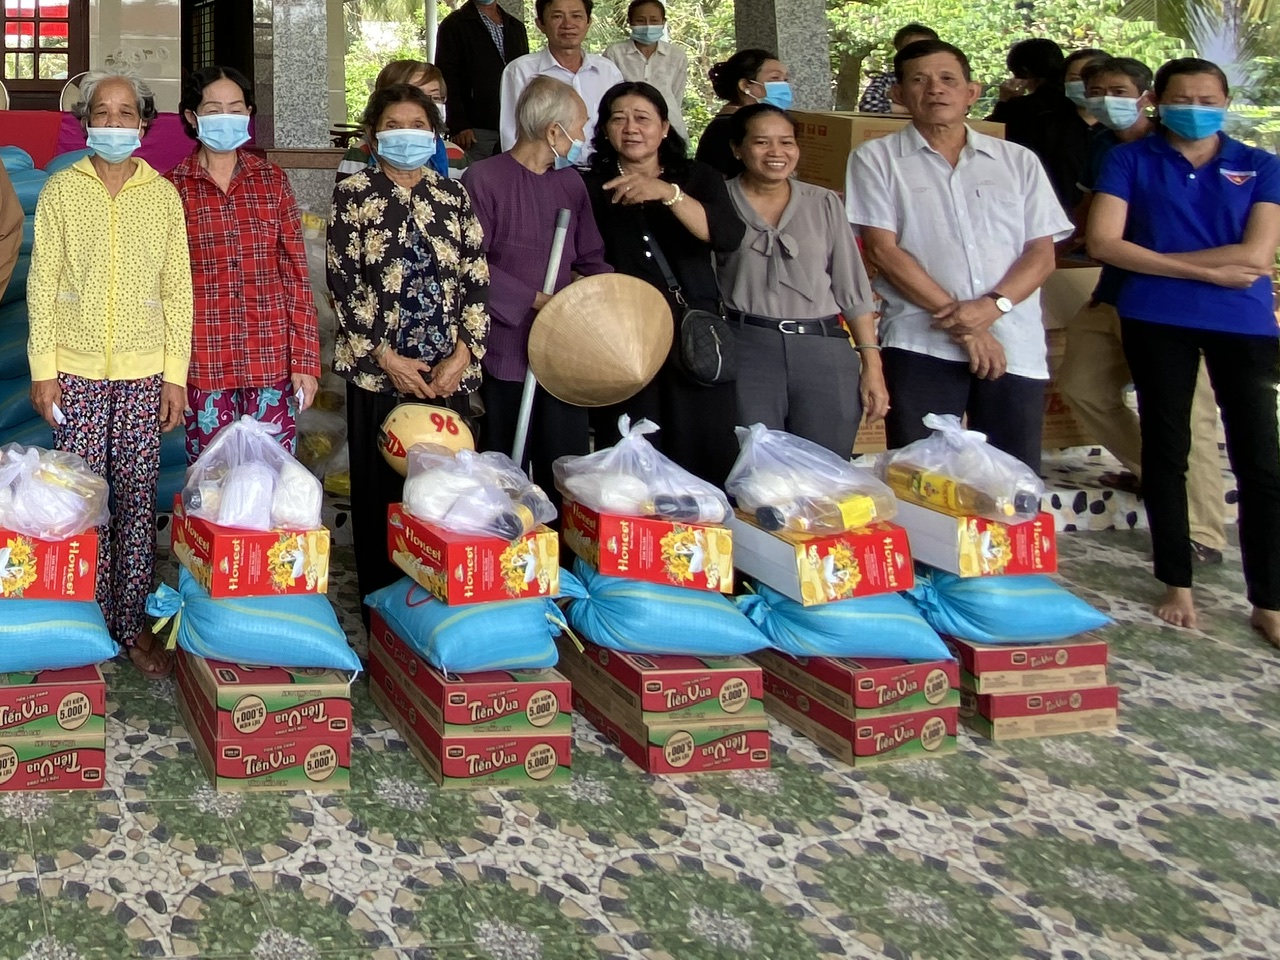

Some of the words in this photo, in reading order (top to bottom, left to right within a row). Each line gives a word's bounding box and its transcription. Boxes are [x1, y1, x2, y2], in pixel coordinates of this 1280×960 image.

[184, 518, 210, 552] Honest
[406, 526, 442, 560] Honest
[618, 520, 629, 571] Honest
[69, 541, 80, 596] Honest
[229, 538, 240, 590] Honest
[465, 546, 474, 597] Honest
